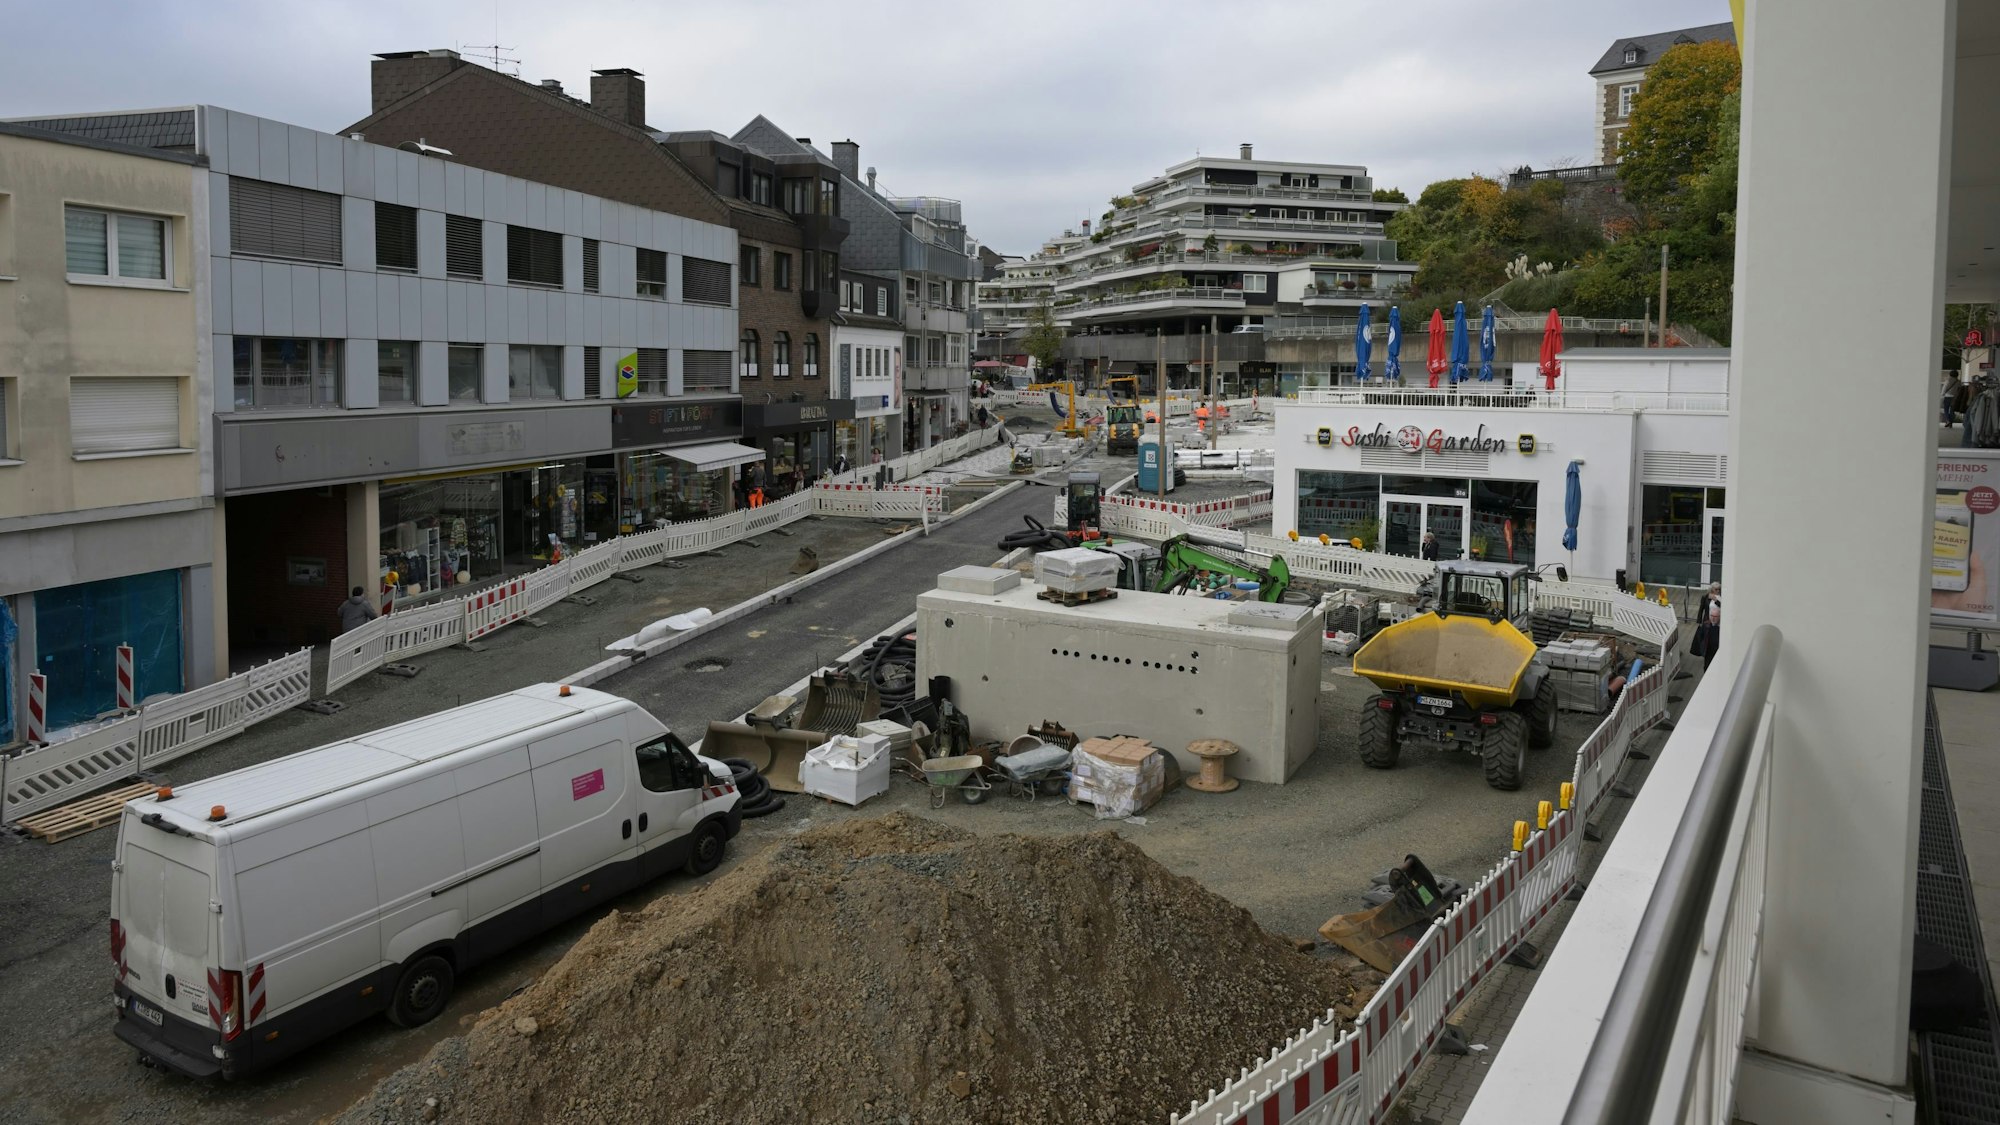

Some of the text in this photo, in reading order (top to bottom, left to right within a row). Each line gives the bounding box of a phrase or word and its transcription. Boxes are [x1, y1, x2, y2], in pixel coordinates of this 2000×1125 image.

[649, 408, 680, 425] STIFT
[1341, 422, 1506, 455] Sushi Garden
[1936, 463, 1988, 473] FRIENDS
[1936, 473, 1974, 483] MEHR!
[1938, 535, 1968, 545] RABATT
